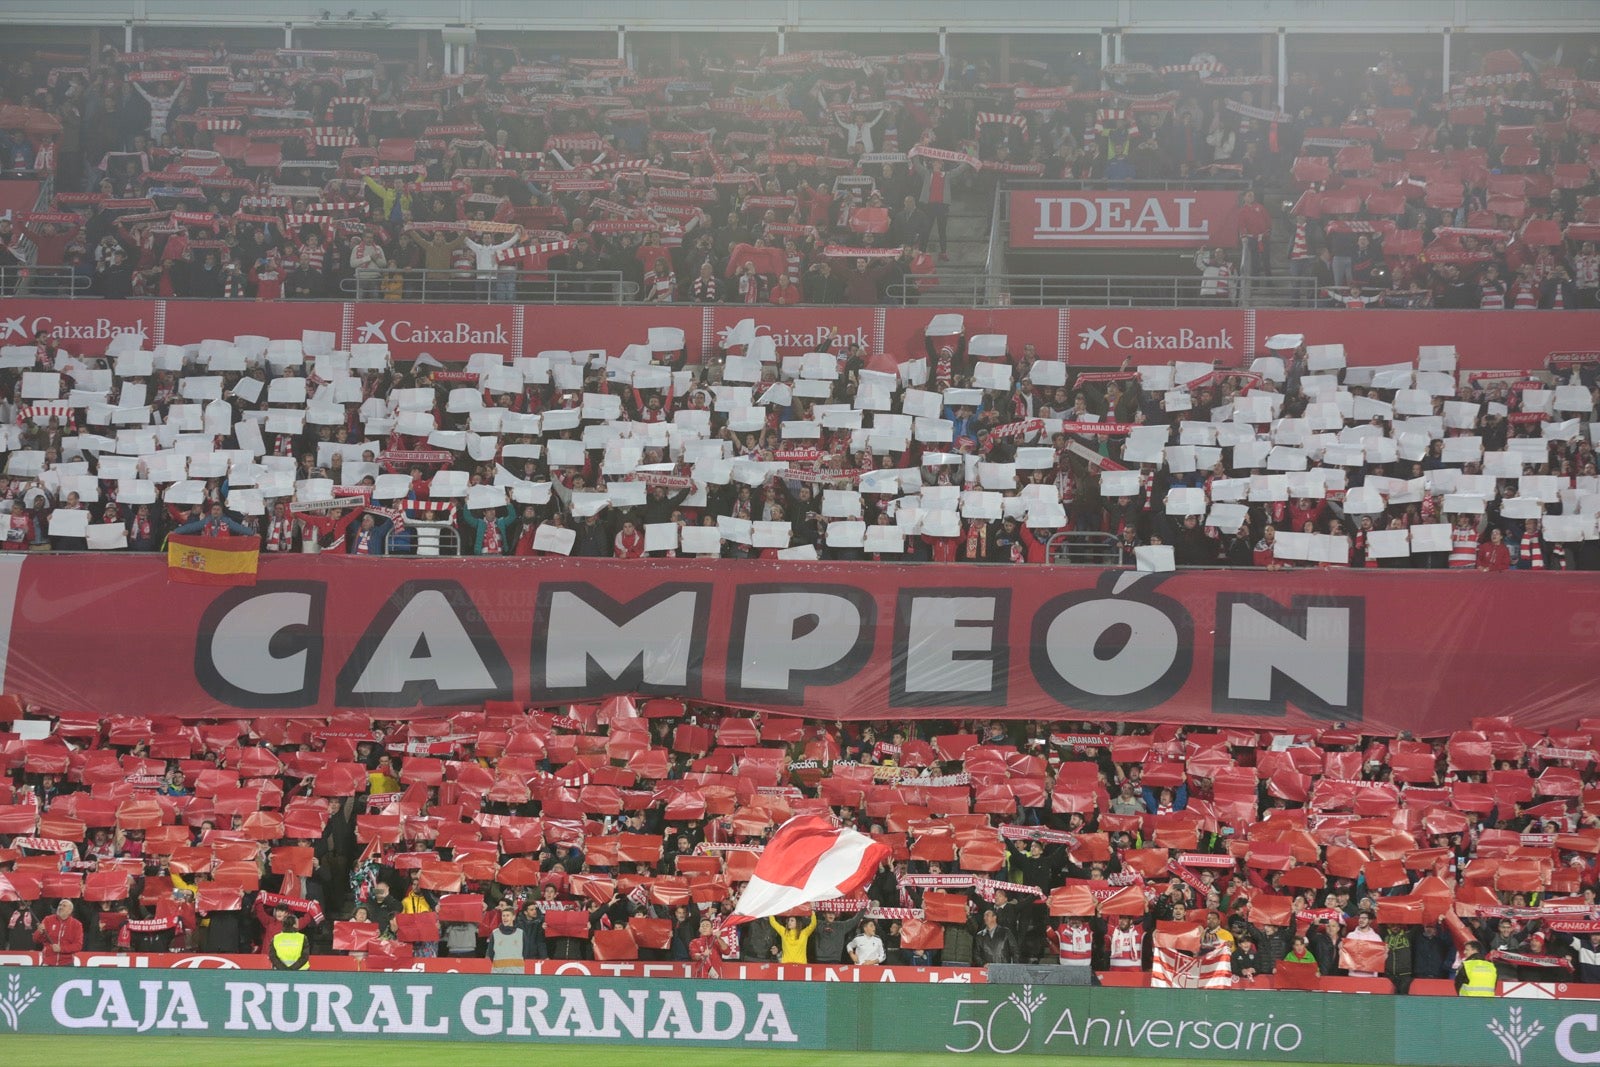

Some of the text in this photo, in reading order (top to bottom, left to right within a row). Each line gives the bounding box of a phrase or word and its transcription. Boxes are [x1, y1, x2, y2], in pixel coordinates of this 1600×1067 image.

[922, 148, 956, 160] GRANADA
[1033, 197, 1209, 233] IDEAL
[31, 316, 150, 340] CaixaBank
[390, 320, 510, 346] CaixaBank
[1112, 325, 1234, 351] CaixaBank
[1082, 424, 1115, 432] GRANADA
[776, 450, 809, 458] GRANADA
[209, 569, 1352, 708] CAMPEÓN
[1067, 736, 1099, 744] GRANADA
[1551, 921, 1589, 931] GRANADA
[50, 979, 799, 1043] CAJA RURAL GRANADA
[945, 1000, 1304, 1055] 50 Aniversario
